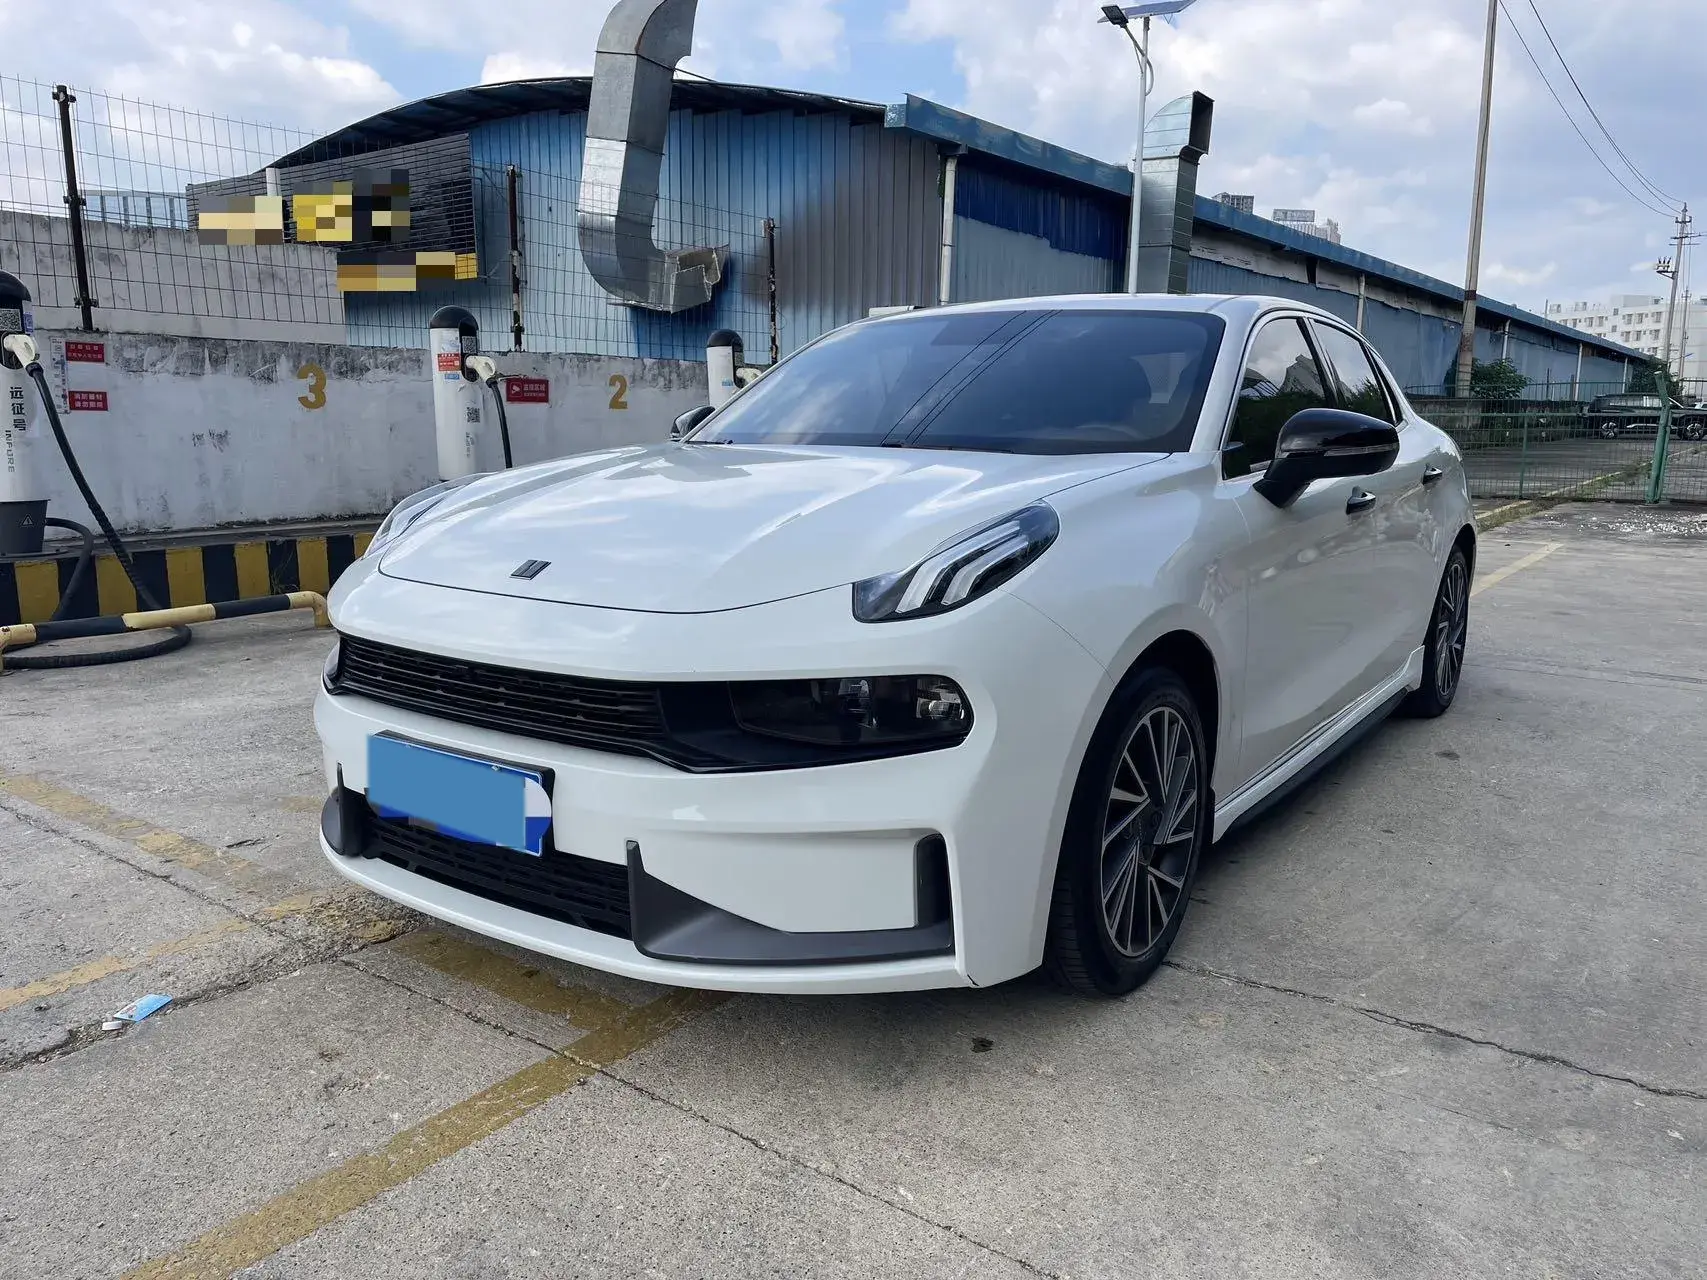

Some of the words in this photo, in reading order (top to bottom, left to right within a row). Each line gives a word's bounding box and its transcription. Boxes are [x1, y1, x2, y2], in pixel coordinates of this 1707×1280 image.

[10, 386, 27, 431] 远征号
[297, 363, 327, 410] 3
[609, 374, 628, 410] 2
